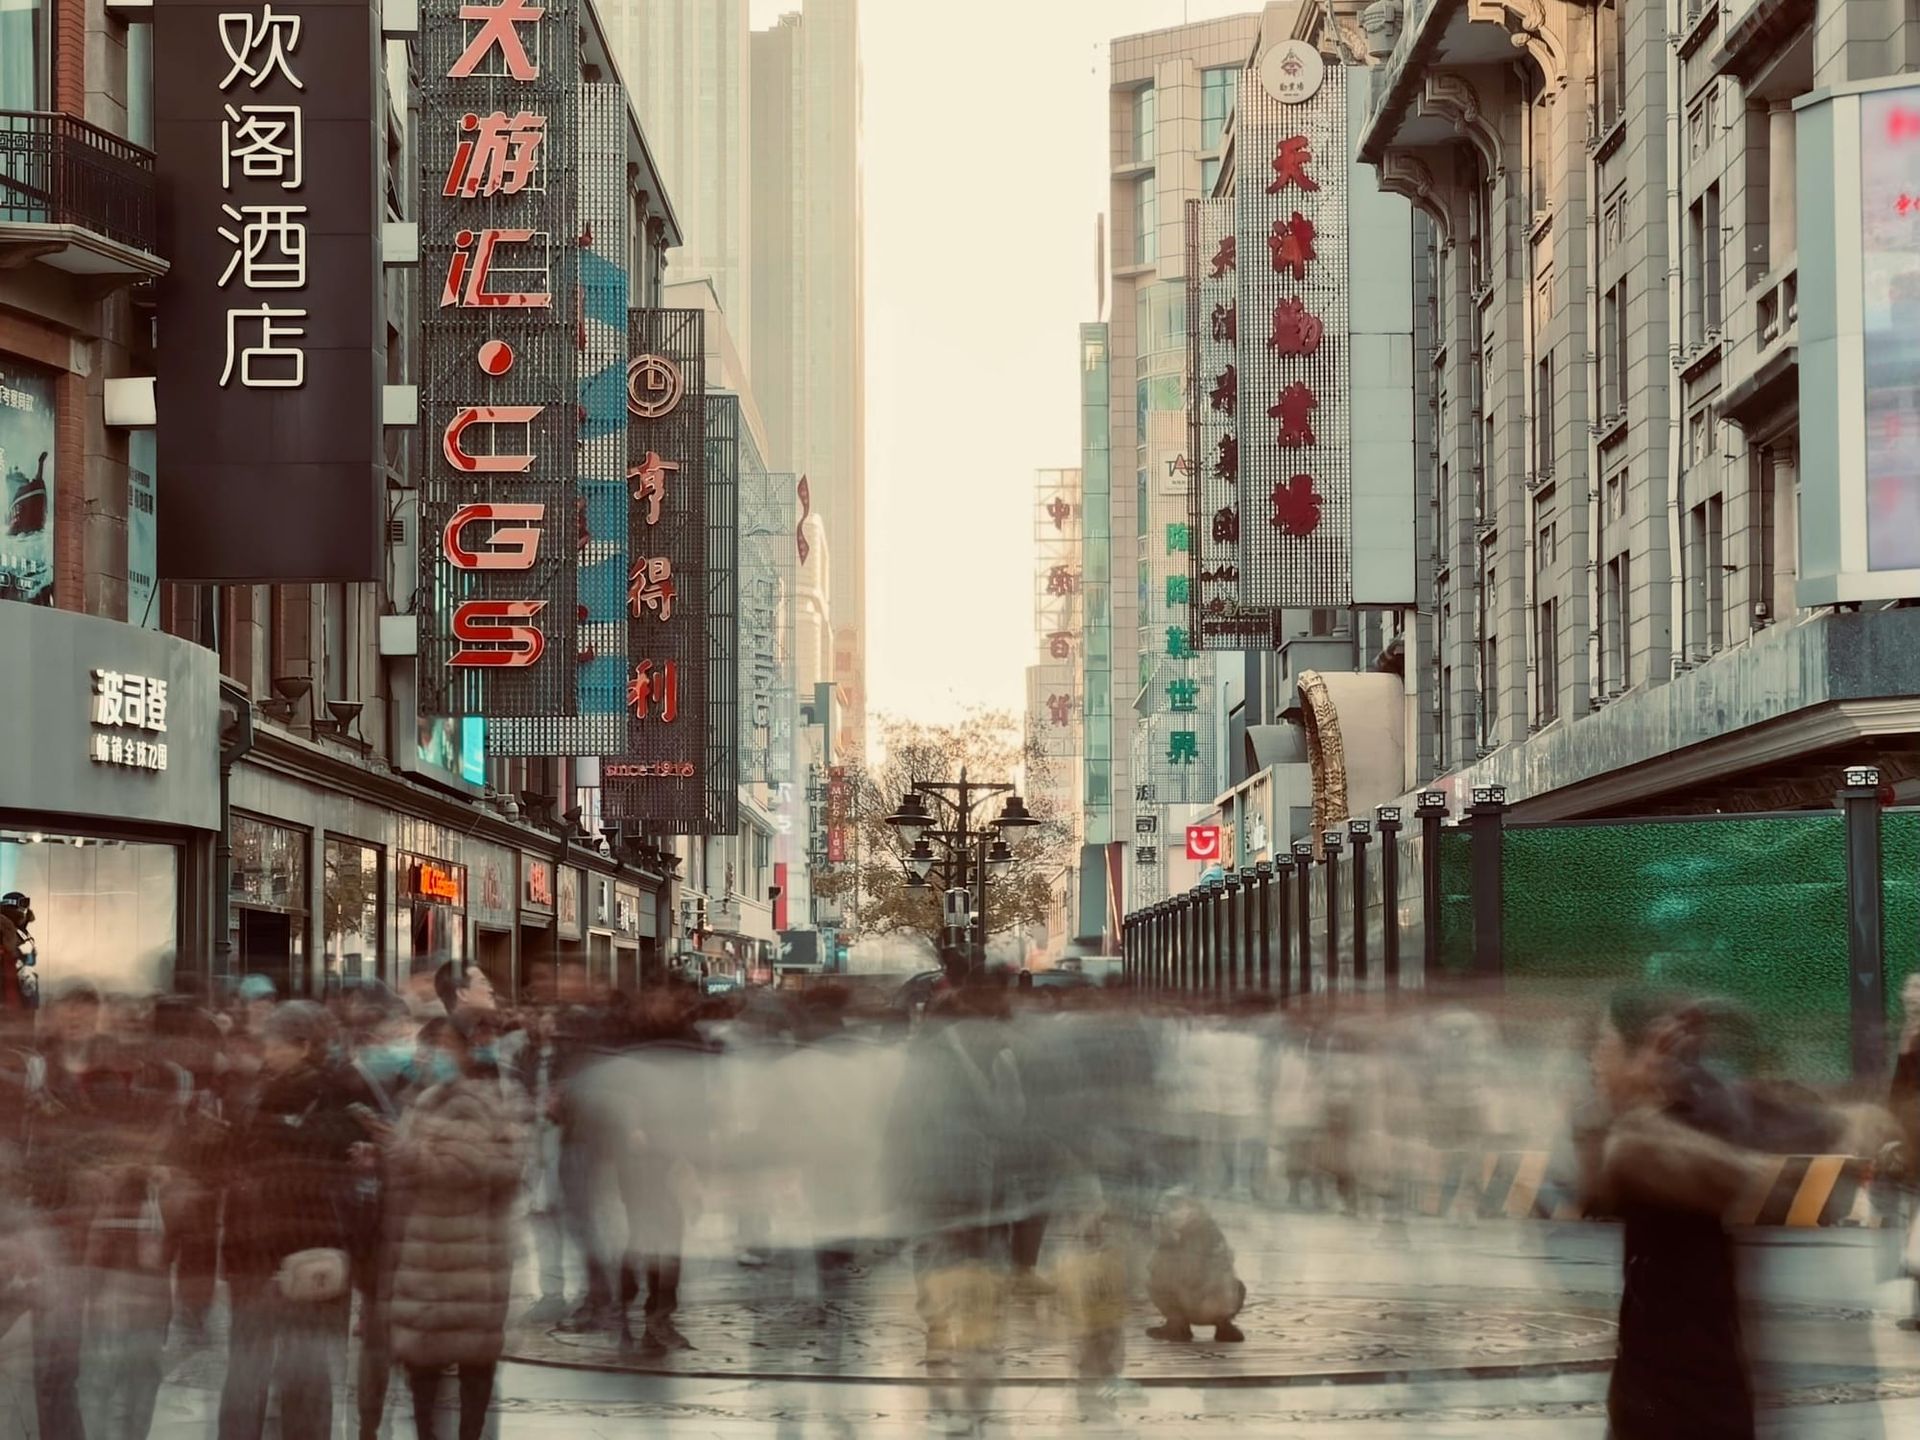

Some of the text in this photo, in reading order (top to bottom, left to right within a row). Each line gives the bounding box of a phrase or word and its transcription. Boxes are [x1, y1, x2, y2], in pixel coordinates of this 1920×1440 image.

[217, 3, 307, 388] 欢阁酒店
[95, 668, 168, 733] 波司登
